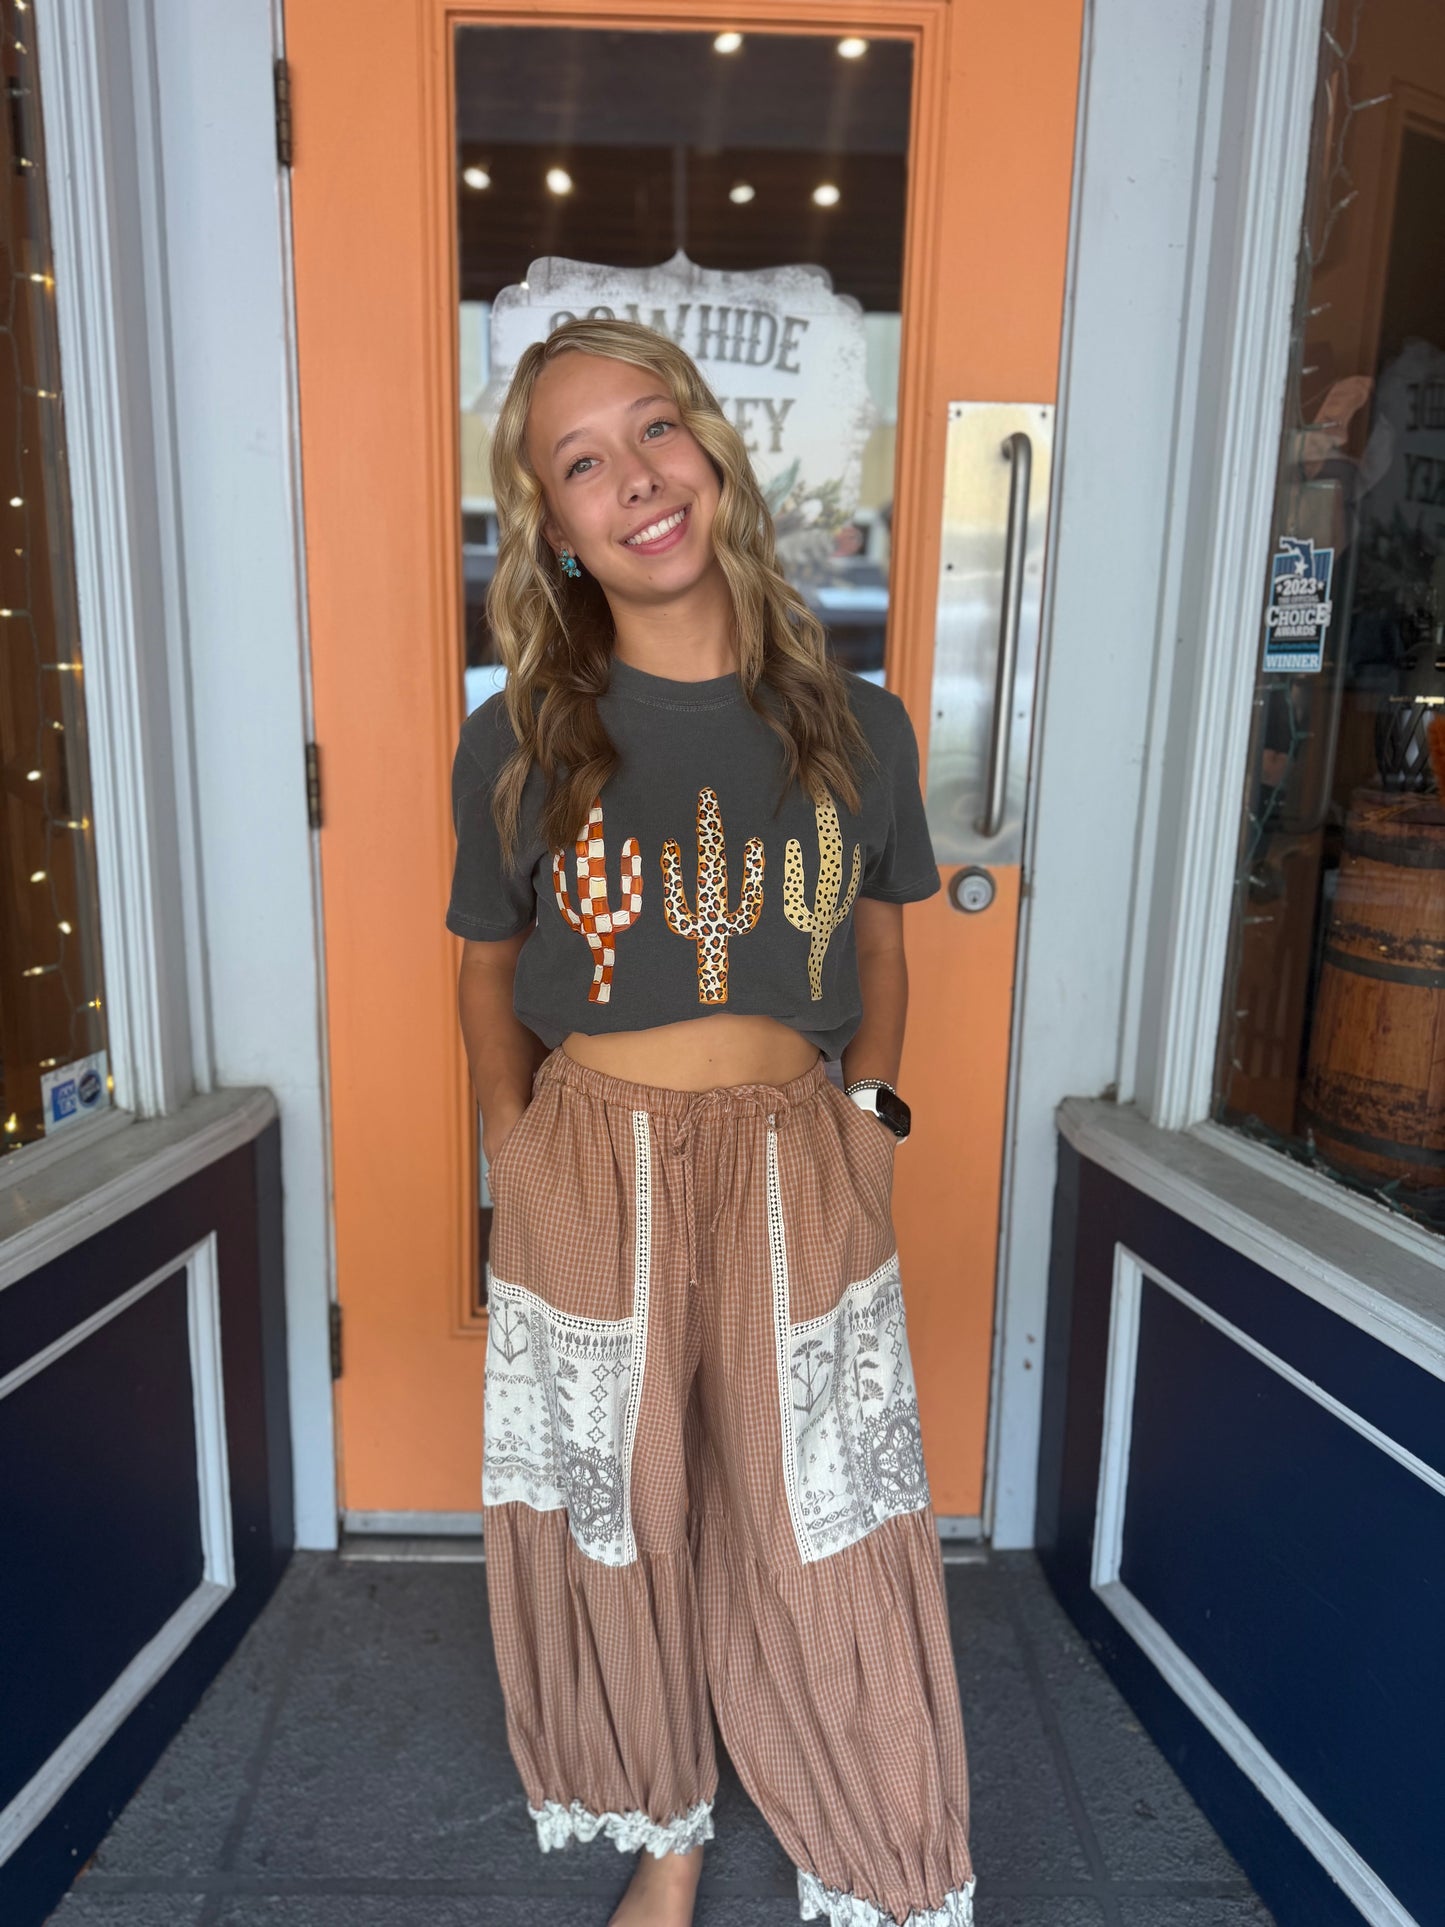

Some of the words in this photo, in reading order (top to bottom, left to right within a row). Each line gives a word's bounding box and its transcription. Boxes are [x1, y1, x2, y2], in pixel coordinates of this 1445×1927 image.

[550, 304, 809, 374] WHIDE
[719, 397, 797, 453] EY
[1283, 578, 1318, 595] 2023
[1267, 602, 1332, 627] CHOICE
[1274, 625, 1316, 638] AWARDS
[1266, 654, 1319, 668] WINNER
